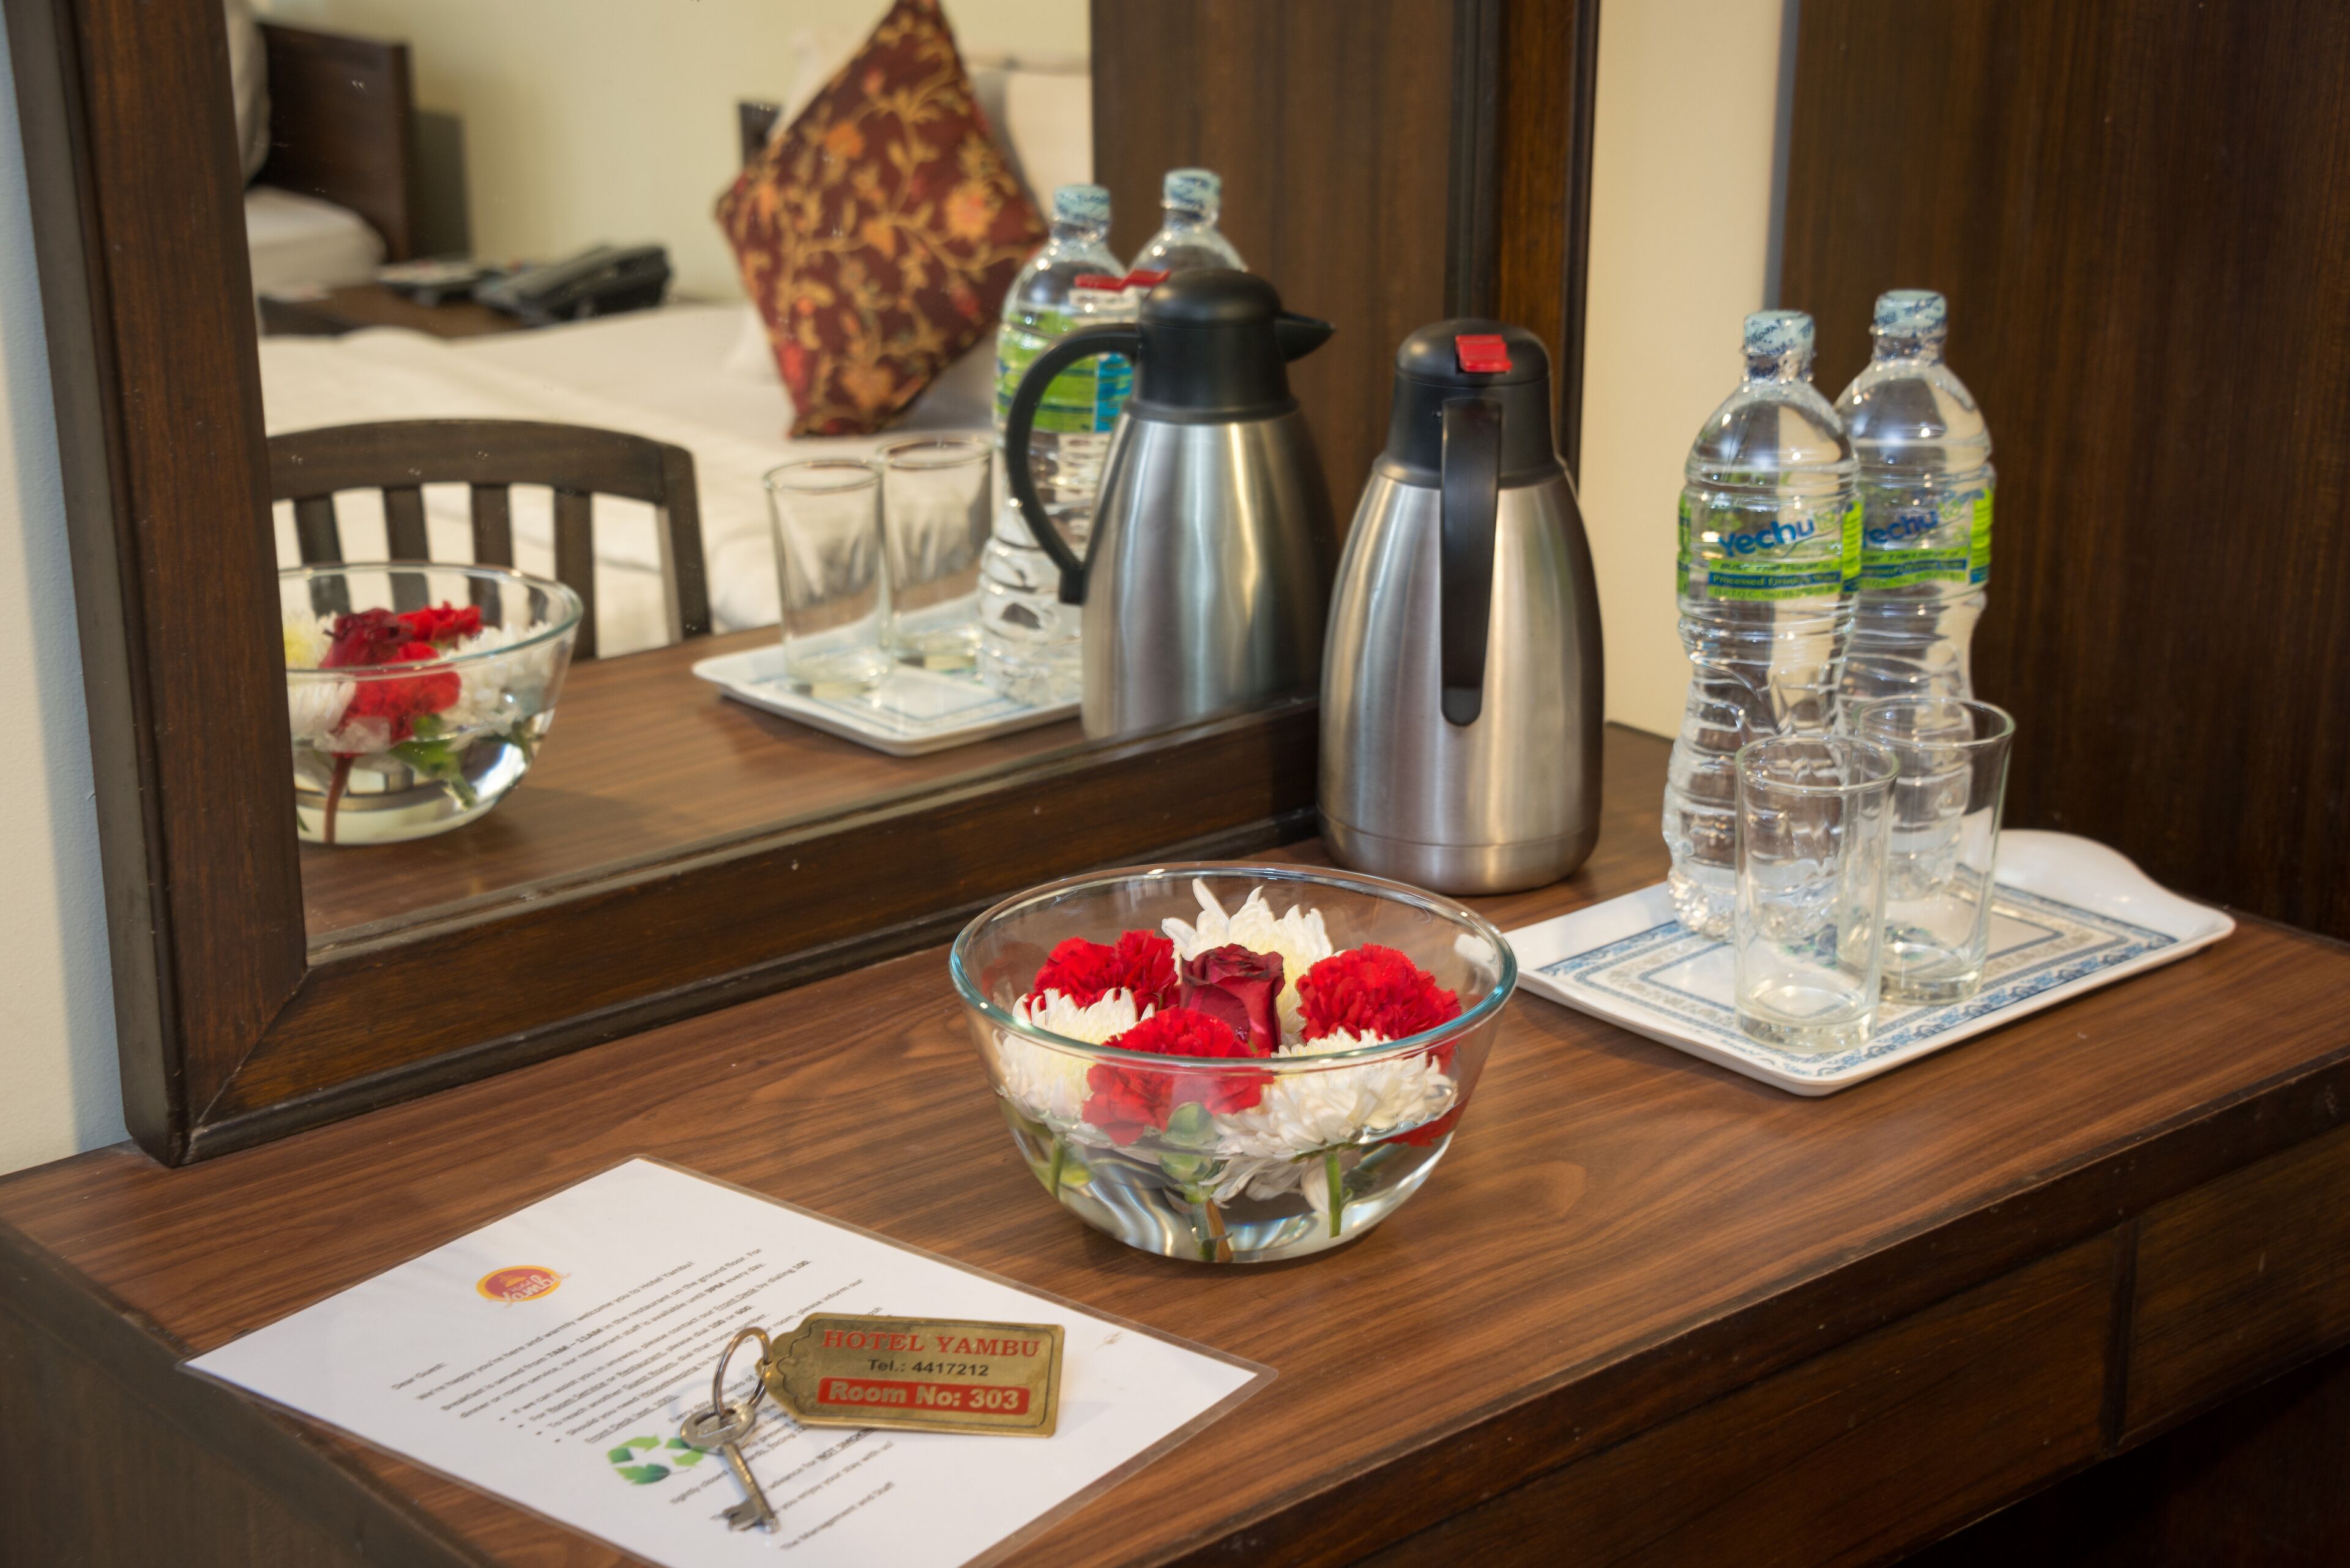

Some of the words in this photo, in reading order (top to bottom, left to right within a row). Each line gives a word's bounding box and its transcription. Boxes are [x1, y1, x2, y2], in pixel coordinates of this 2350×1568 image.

[1717, 519, 1815, 558] Yechu
[487, 1273, 571, 1309] Yambu
[441, 1388, 487, 1411] Breakfast
[494, 1368, 525, 1384] served
[523, 1357, 548, 1369] from
[545, 1346, 570, 1357] 7AM
[576, 1328, 604, 1343] 11AM
[629, 1295, 672, 1316] restaurant
[697, 1266, 727, 1283] ground
[725, 1256, 748, 1267] floor.
[444, 1372, 476, 1386] happy
[474, 1357, 504, 1372] you're
[502, 1346, 526, 1357] here
[525, 1337, 543, 1346] and
[543, 1321, 576, 1337] warmly
[575, 1302, 614, 1321] welcome
[613, 1294, 630, 1302] you
[639, 1277, 663, 1289] Hotel
[660, 1261, 694, 1277] Yambu!
[460, 1402, 490, 1418] dinner
[502, 1383, 528, 1397] room
[562, 1357, 578, 1367] our
[578, 1335, 623, 1358] restaurant
[622, 1324, 642, 1335] staff
[651, 1303, 687, 1321] available
[686, 1293, 706, 1303] until
[704, 1283, 726, 1293] 9PM
[726, 1271, 748, 1283] every
[535, 1393, 553, 1402] can
[553, 1379, 579, 1394] assist
[577, 1371, 597, 1381] you
[605, 1350, 642, 1367] anyway,
[641, 1334, 669, 1349] please
[668, 1318, 700, 1334] contact
[699, 1310, 714, 1318] our
[712, 1298, 739, 1311] Front
[735, 1288, 759, 1299] Desk
[767, 1269, 796, 1283] dialing
[793, 1261, 811, 1269] 100.
[822, 1329, 925, 1351] HOTEL
[935, 1336, 1040, 1357] YAMBU
[392, 1378, 415, 1389] Dear
[529, 1412, 546, 1421] For
[545, 1398, 577, 1413] Room
[573, 1381, 609, 1400] Service
[666, 1337, 693, 1352] please
[693, 1328, 709, 1337] dial
[708, 1320, 726, 1329] 100
[562, 1408, 589, 1422] reach
[588, 1389, 622, 1408] another
[622, 1375, 652, 1390] Guest
[677, 1352, 695, 1361] dial
[692, 1343, 713, 1353] that
[712, 1331, 735, 1343] room
[735, 1314, 769, 1332] number.
[566, 1418, 600, 1436] Should
[599, 1409, 617, 1419] you
[616, 1397, 640, 1409] need
[638, 1365, 701, 1398] Housekeeping
[772, 1315, 798, 1327] room,
[797, 1301, 823, 1315] please
[820, 1287, 849, 1301] inform
[868, 1359, 906, 1372] Tel.:
[912, 1361, 989, 1376] 4417212
[829, 1380, 907, 1404] Room
[916, 1386, 960, 1406] No:
[969, 1389, 1020, 1409] 303
[584, 1428, 614, 1444] Front
[610, 1417, 636, 1430] Desk
[670, 1487, 701, 1504] tightly
[768, 1468, 804, 1490] advance
[802, 1459, 818, 1468] for
[816, 1447, 840, 1461] NOT
[780, 1499, 797, 1510] you
[798, 1484, 822, 1499] enjoy
[821, 1472, 841, 1485] your
[842, 1462, 862, 1473] stay
[860, 1450, 881, 1462] with
[880, 1441, 894, 1450] us!
[780, 1540, 800, 1550] The
[798, 1505, 858, 1540] Management
[857, 1495, 875, 1506] and
[873, 1482, 895, 1495] Staff
